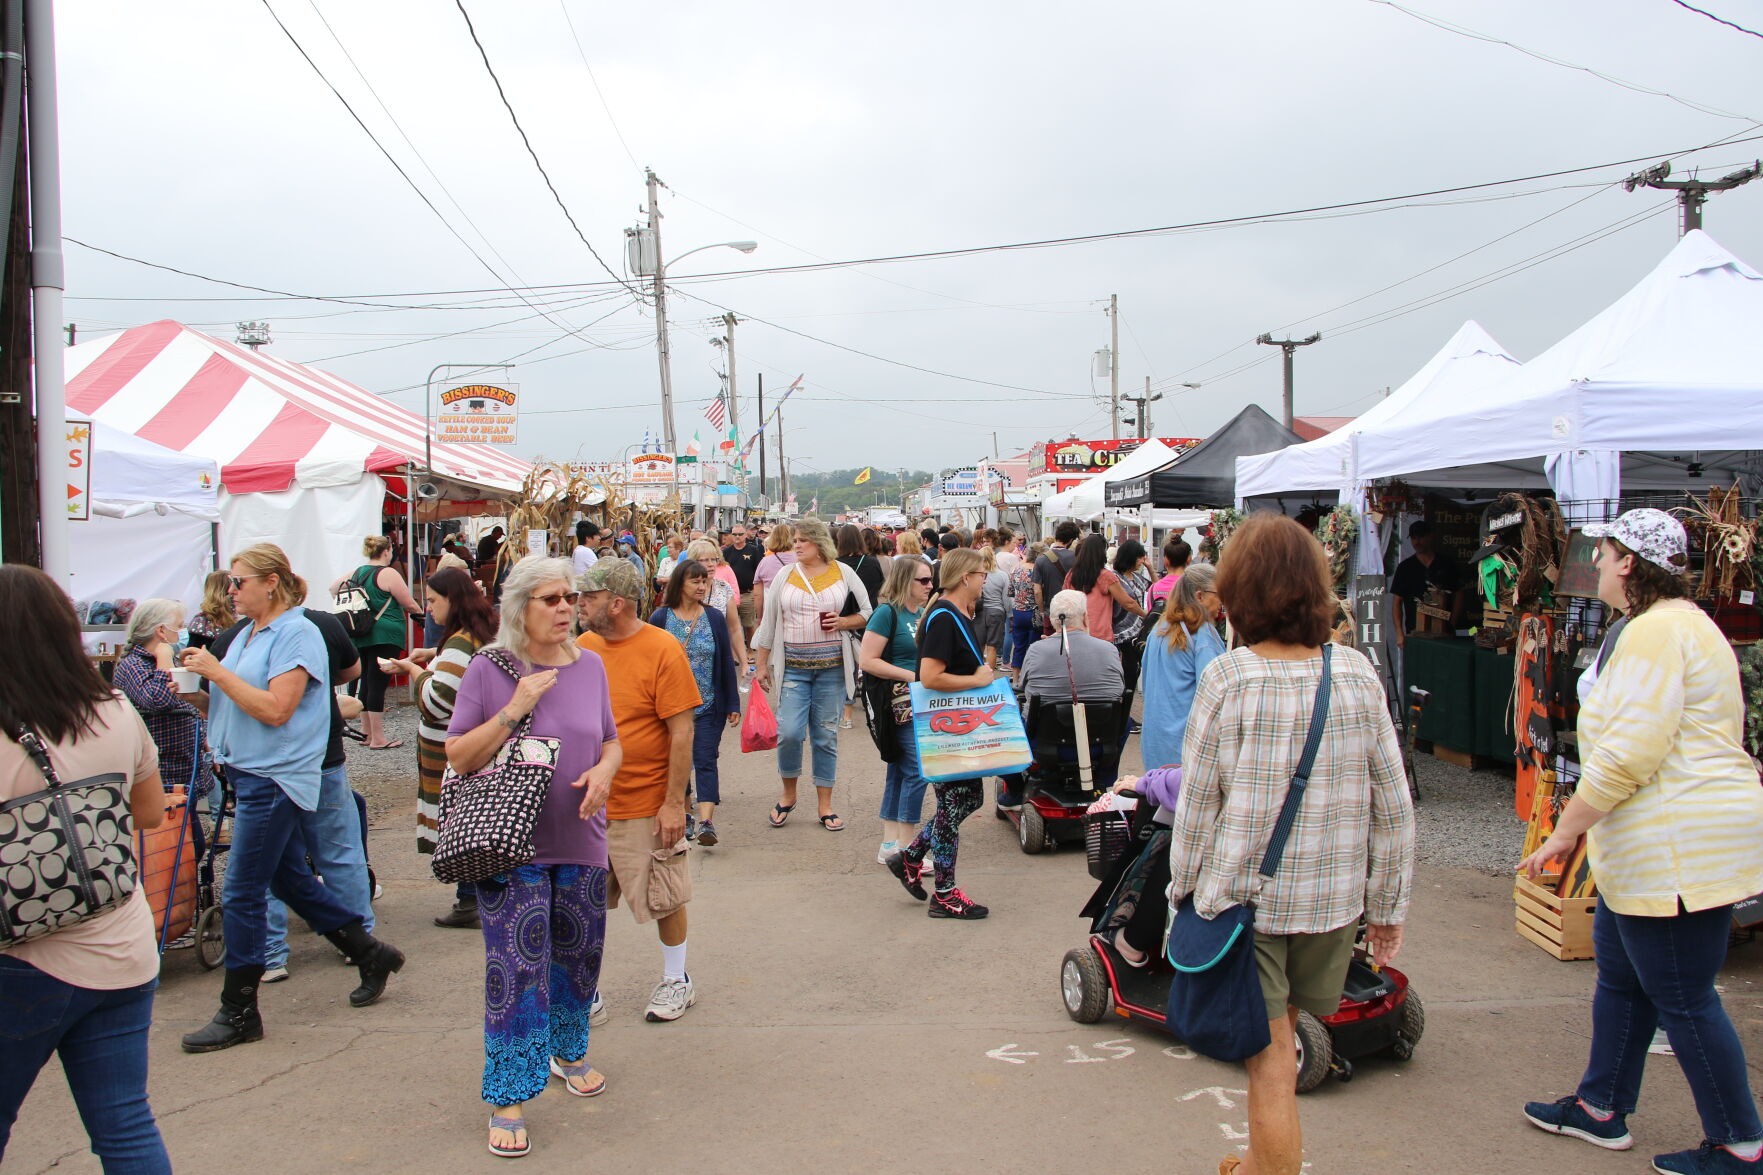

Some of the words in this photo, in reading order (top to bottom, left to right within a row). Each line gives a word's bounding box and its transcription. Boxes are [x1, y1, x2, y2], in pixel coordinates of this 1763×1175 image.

[441, 385, 516, 406] BISSINGER'S
[438, 416, 465, 424] KETTLE
[445, 426, 468, 434] HAM
[481, 426, 509, 434] BEAN
[437, 434, 488, 443] VEGETABLE
[490, 434, 515, 443] BEEF
[1055, 453, 1083, 465] TEA
[1434, 511, 1461, 524] The
[1442, 535, 1471, 547] Signs
[1361, 600, 1383, 672] THA
[929, 698, 953, 709] RIDE
[957, 697, 974, 706] THE
[977, 694, 1006, 704] WAVE
